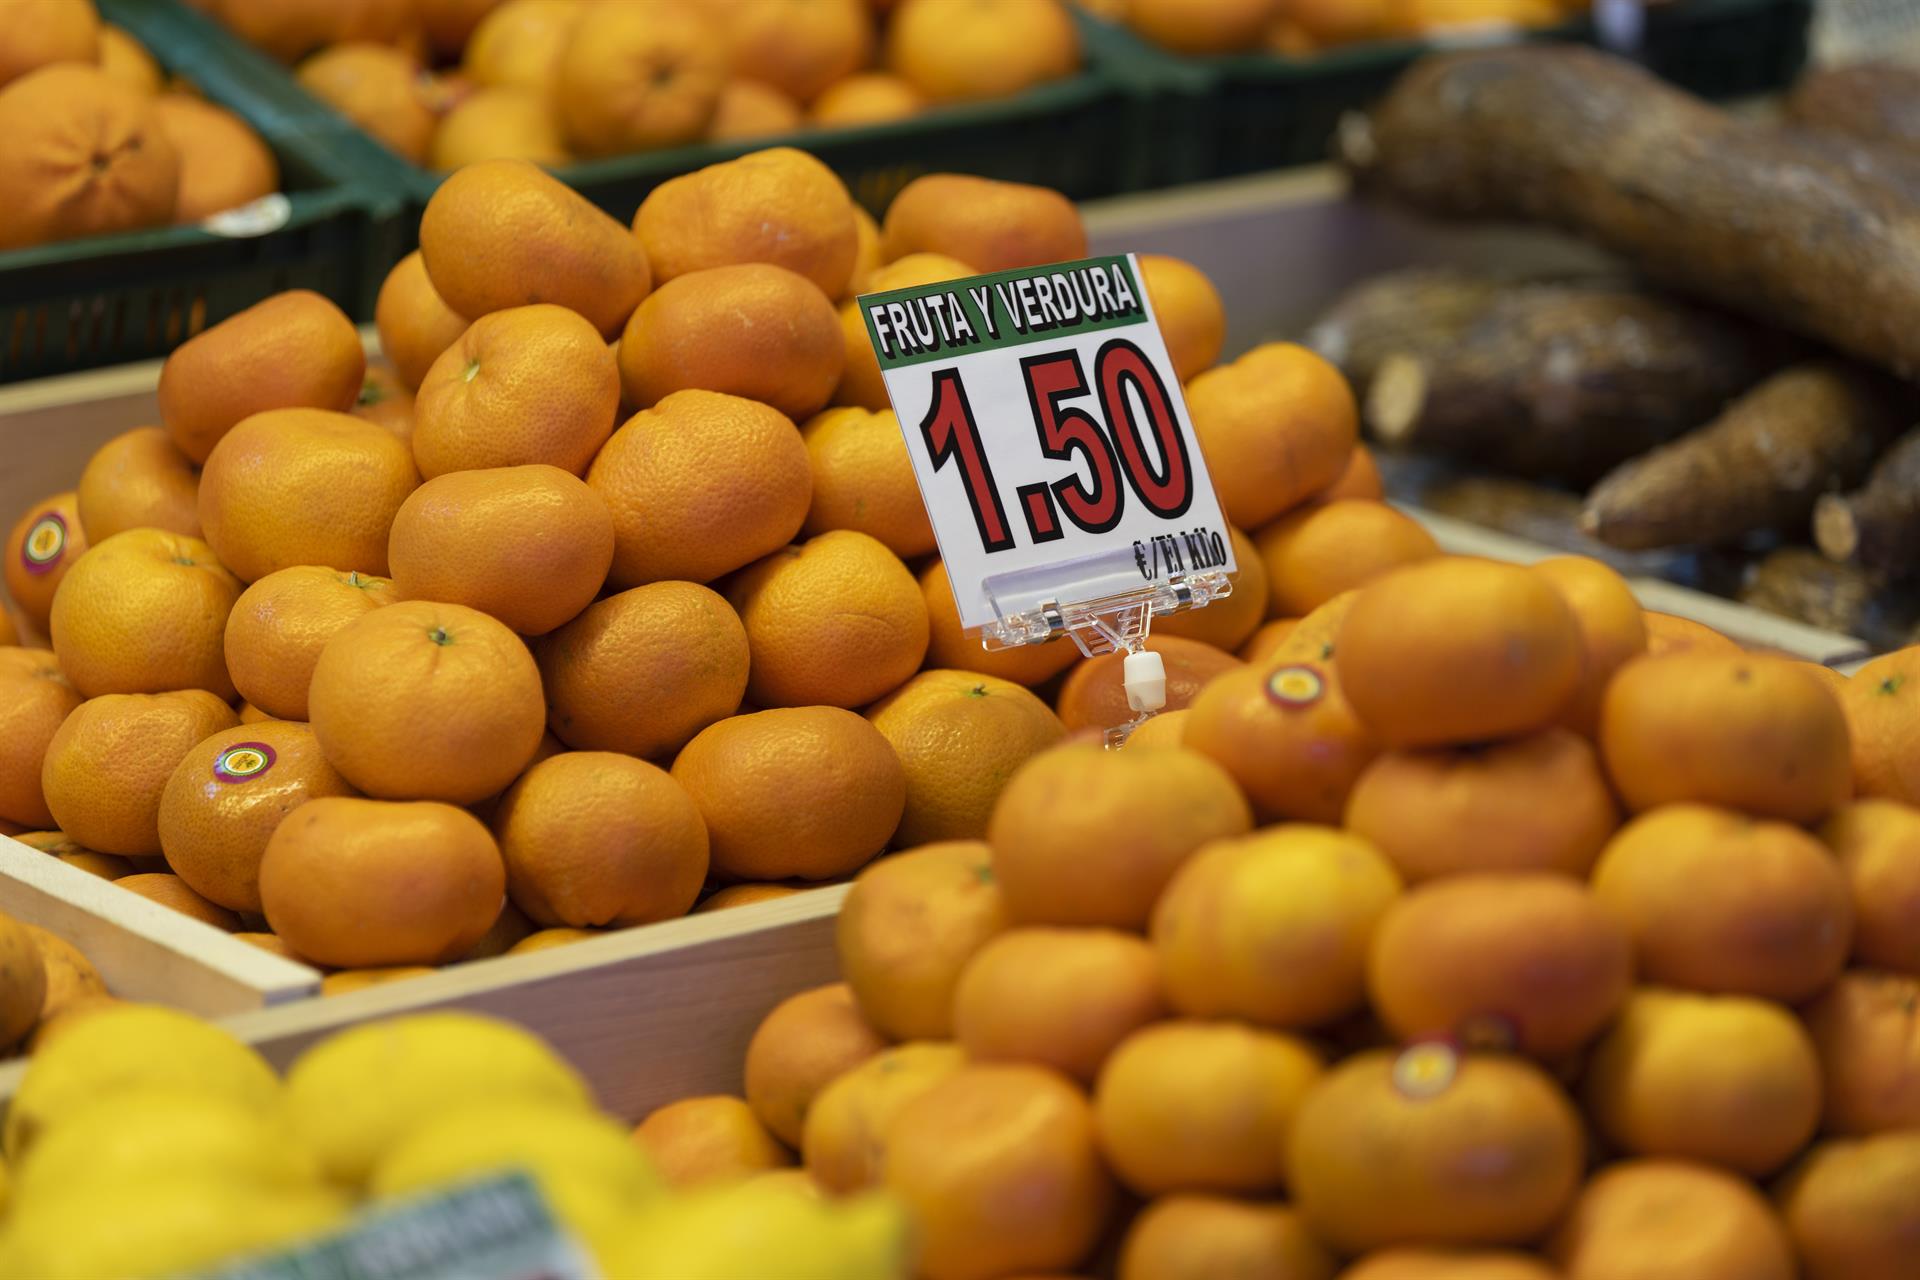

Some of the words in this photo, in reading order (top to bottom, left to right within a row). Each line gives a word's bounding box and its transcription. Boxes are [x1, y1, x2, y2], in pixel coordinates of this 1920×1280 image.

[868, 292, 979, 359] FRUTA
[968, 286, 1000, 340] Y
[995, 263, 1143, 335] VERDURA
[919, 338, 1193, 554] 1.50
